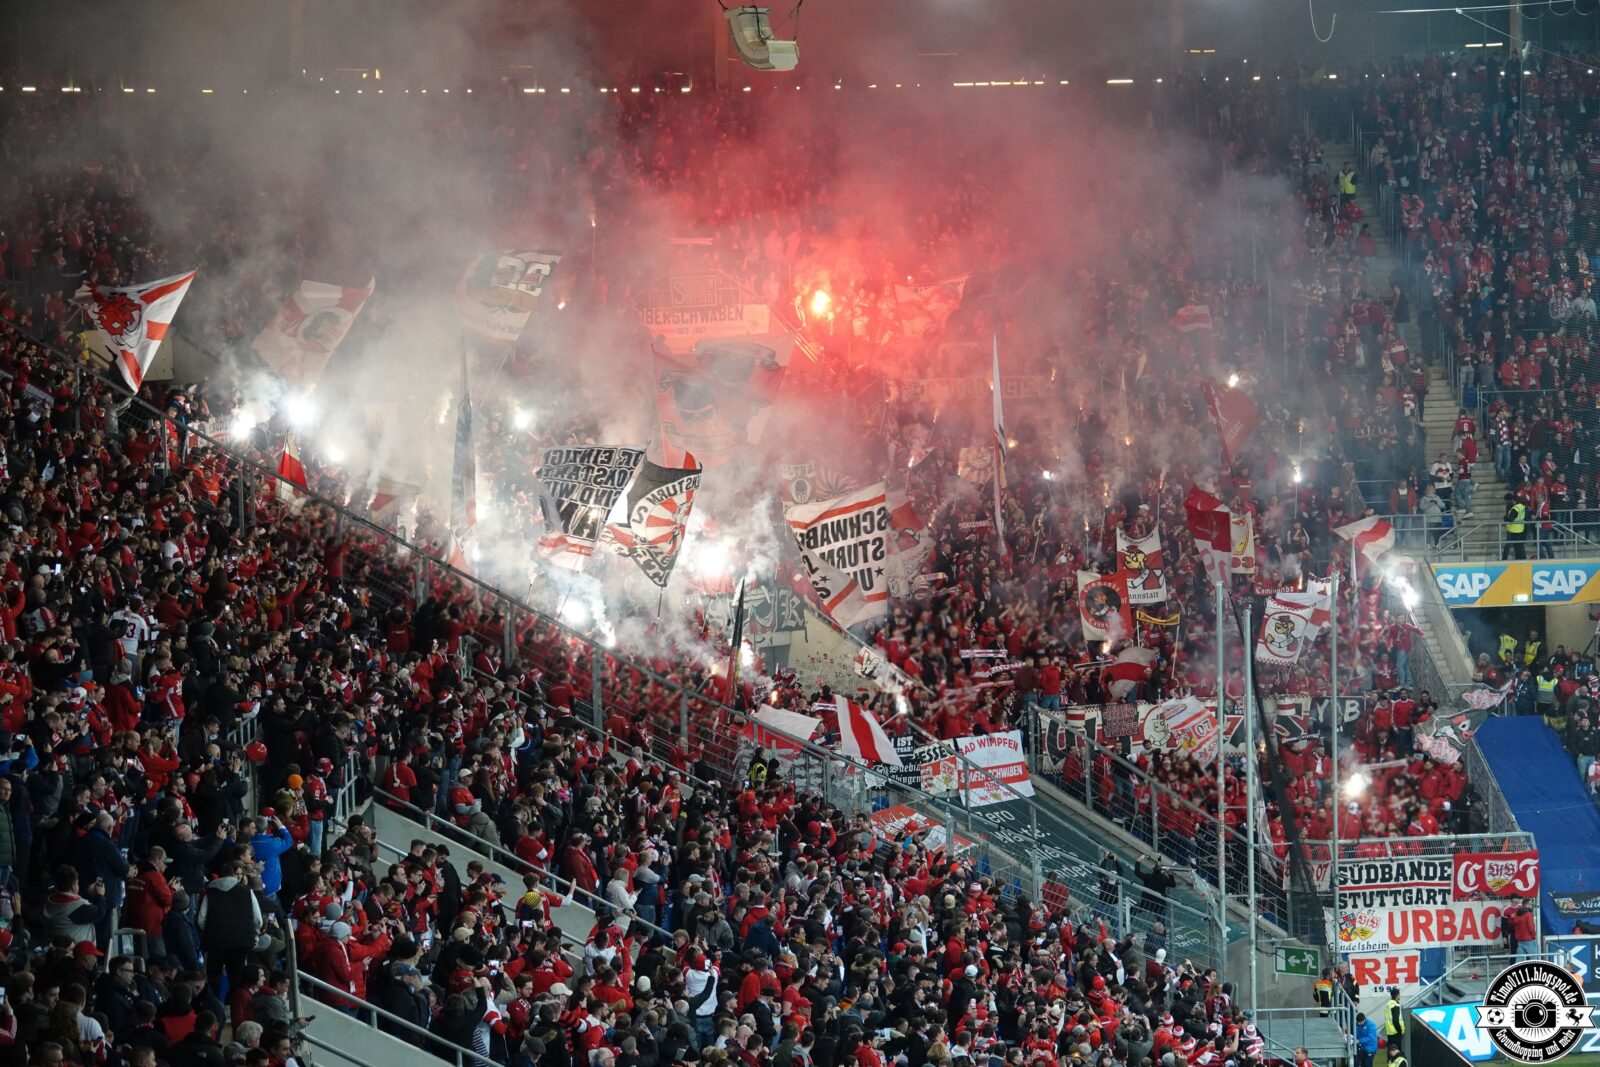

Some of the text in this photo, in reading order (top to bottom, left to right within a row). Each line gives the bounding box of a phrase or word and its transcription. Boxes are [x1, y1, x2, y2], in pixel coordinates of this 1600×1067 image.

[1437, 572, 1491, 599] SAP
[1532, 569, 1587, 596] SAP
[959, 737, 1019, 757] BAD WIMPFEN
[1338, 861, 1452, 885] SÜDBANDE
[1338, 887, 1452, 909] STUTTGART
[1387, 906, 1502, 945] URBAC
[1328, 940, 1390, 952] Gndelsheim
[1351, 956, 1419, 986] RH
